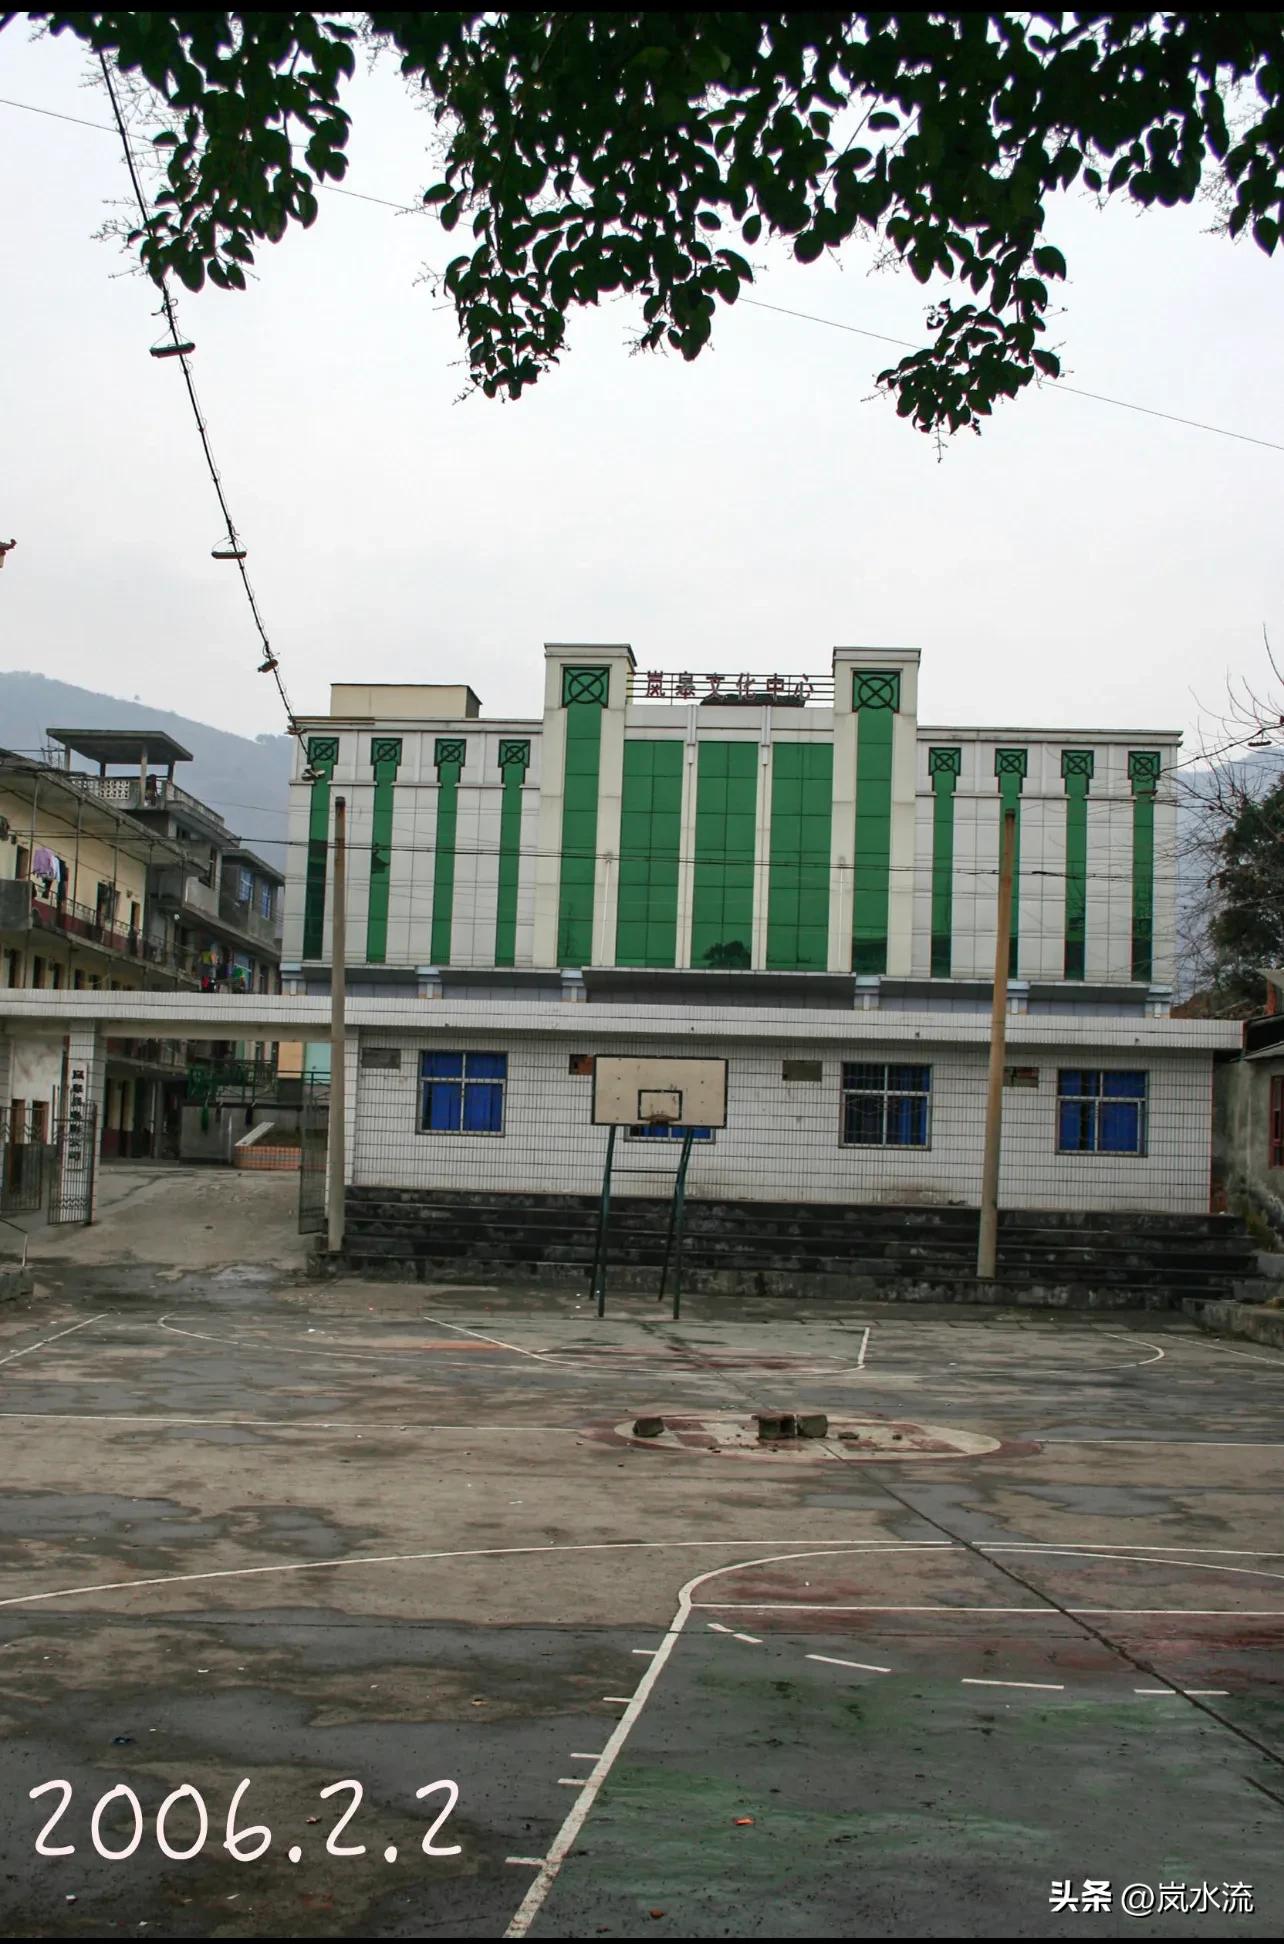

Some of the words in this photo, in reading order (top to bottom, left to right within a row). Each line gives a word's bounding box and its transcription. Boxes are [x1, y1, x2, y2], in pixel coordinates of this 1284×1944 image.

[647, 671, 813, 701] 岚皋文化中心
